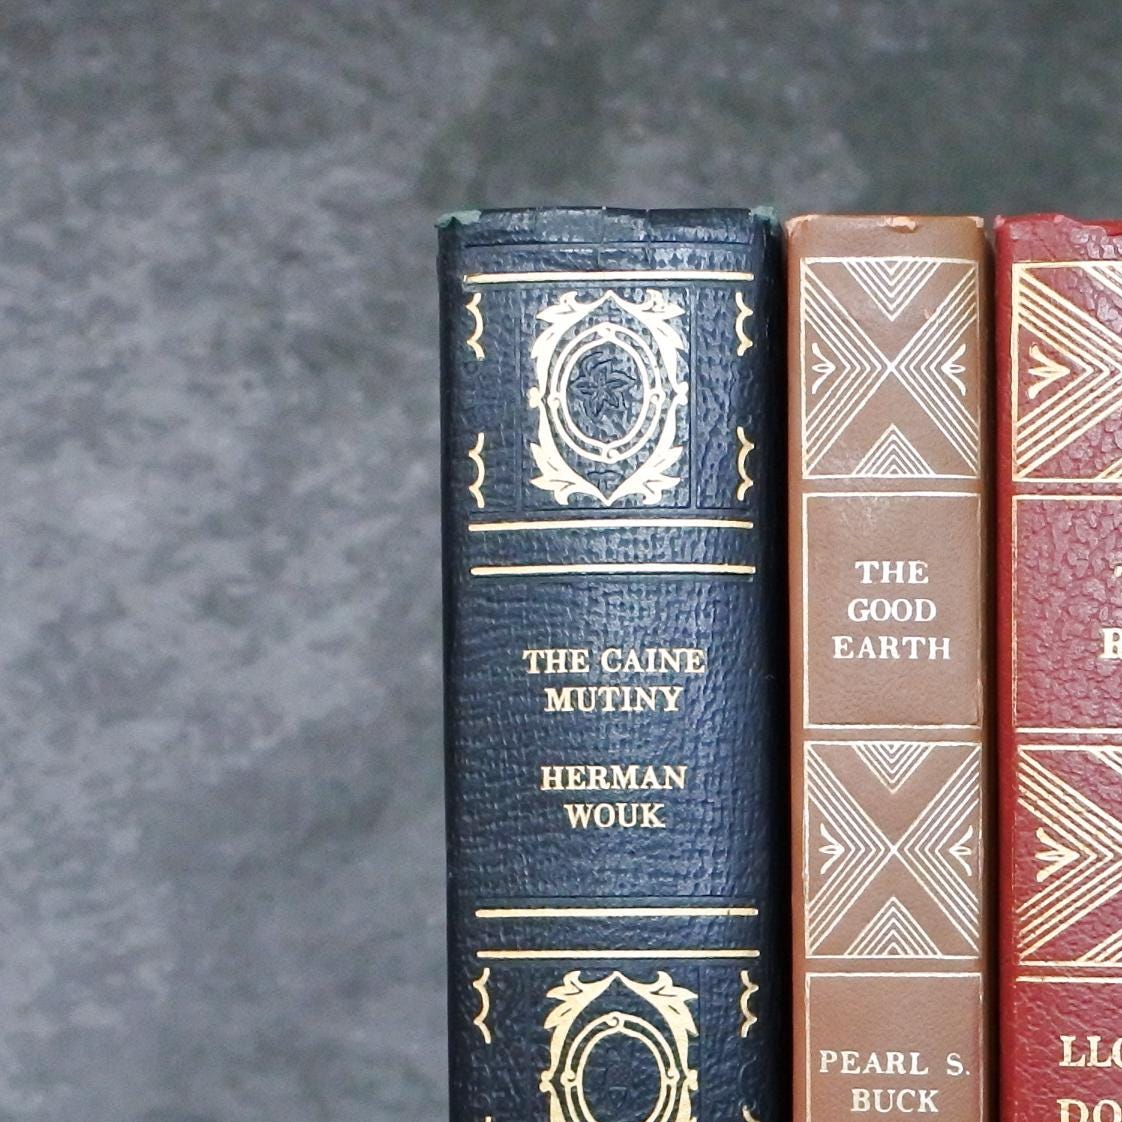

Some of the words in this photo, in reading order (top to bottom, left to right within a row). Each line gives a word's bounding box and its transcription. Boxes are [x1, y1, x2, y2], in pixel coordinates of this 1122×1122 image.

[855, 560, 930, 585] THE
[847, 598, 937, 623] GOOD
[522, 648, 589, 675] THE
[600, 648, 706, 675] CAINE
[832, 636, 952, 661] EARTH
[544, 687, 683, 713] MUTINY
[540, 765, 687, 791] HERMAN
[564, 803, 666, 829] WOUK
[819, 1050, 930, 1075] PEARL
[946, 1051, 971, 1076] S.
[850, 1088, 939, 1113] BUCK
